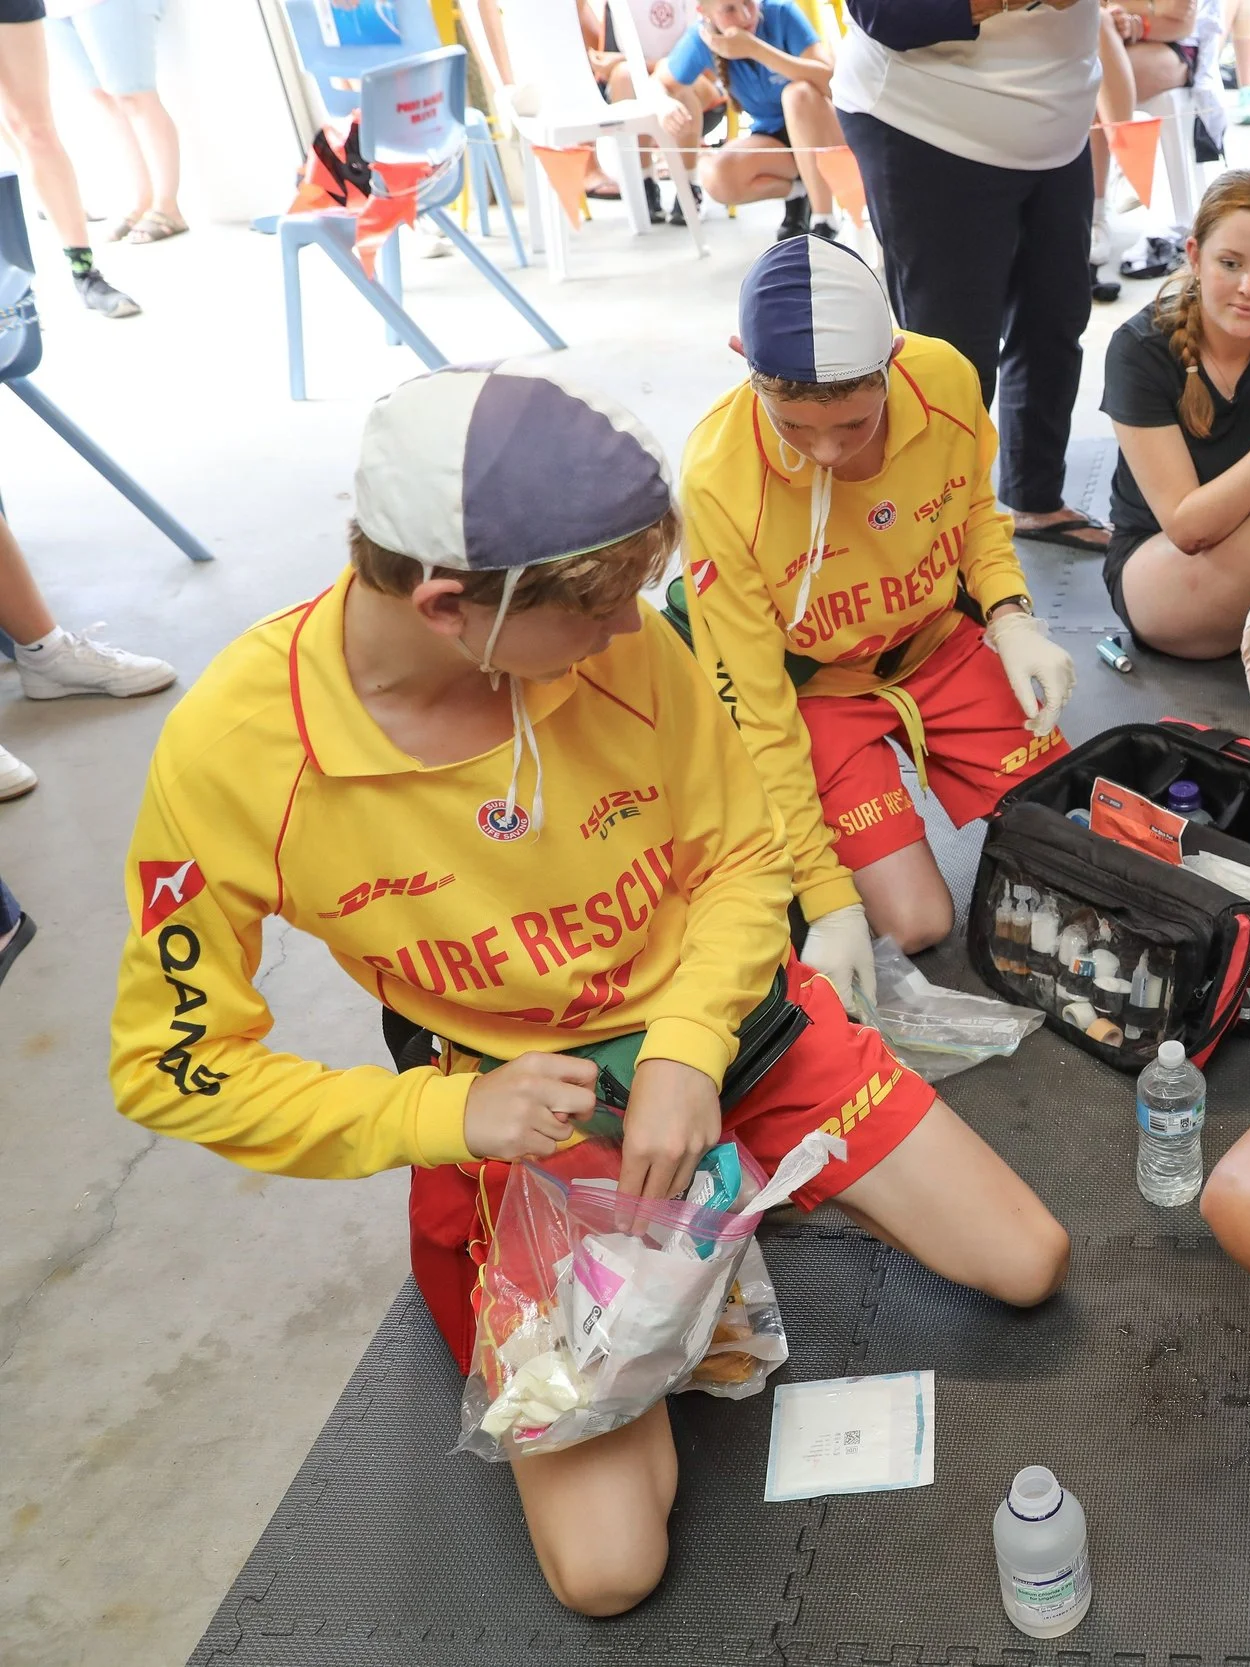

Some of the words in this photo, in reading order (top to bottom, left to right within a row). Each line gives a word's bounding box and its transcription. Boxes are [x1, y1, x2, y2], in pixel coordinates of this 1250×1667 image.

[795, 582, 872, 649] SURF
[879, 519, 968, 615] RESCU
[485, 801, 510, 811] SUR
[579, 785, 660, 840] ISUZU
[598, 806, 642, 841] UTE
[838, 797, 884, 836] SURF
[482, 824, 500, 839] LIFE
[503, 818, 528, 840] SAVING
[336, 871, 441, 918] DHL
[511, 836, 675, 977] RESCU
